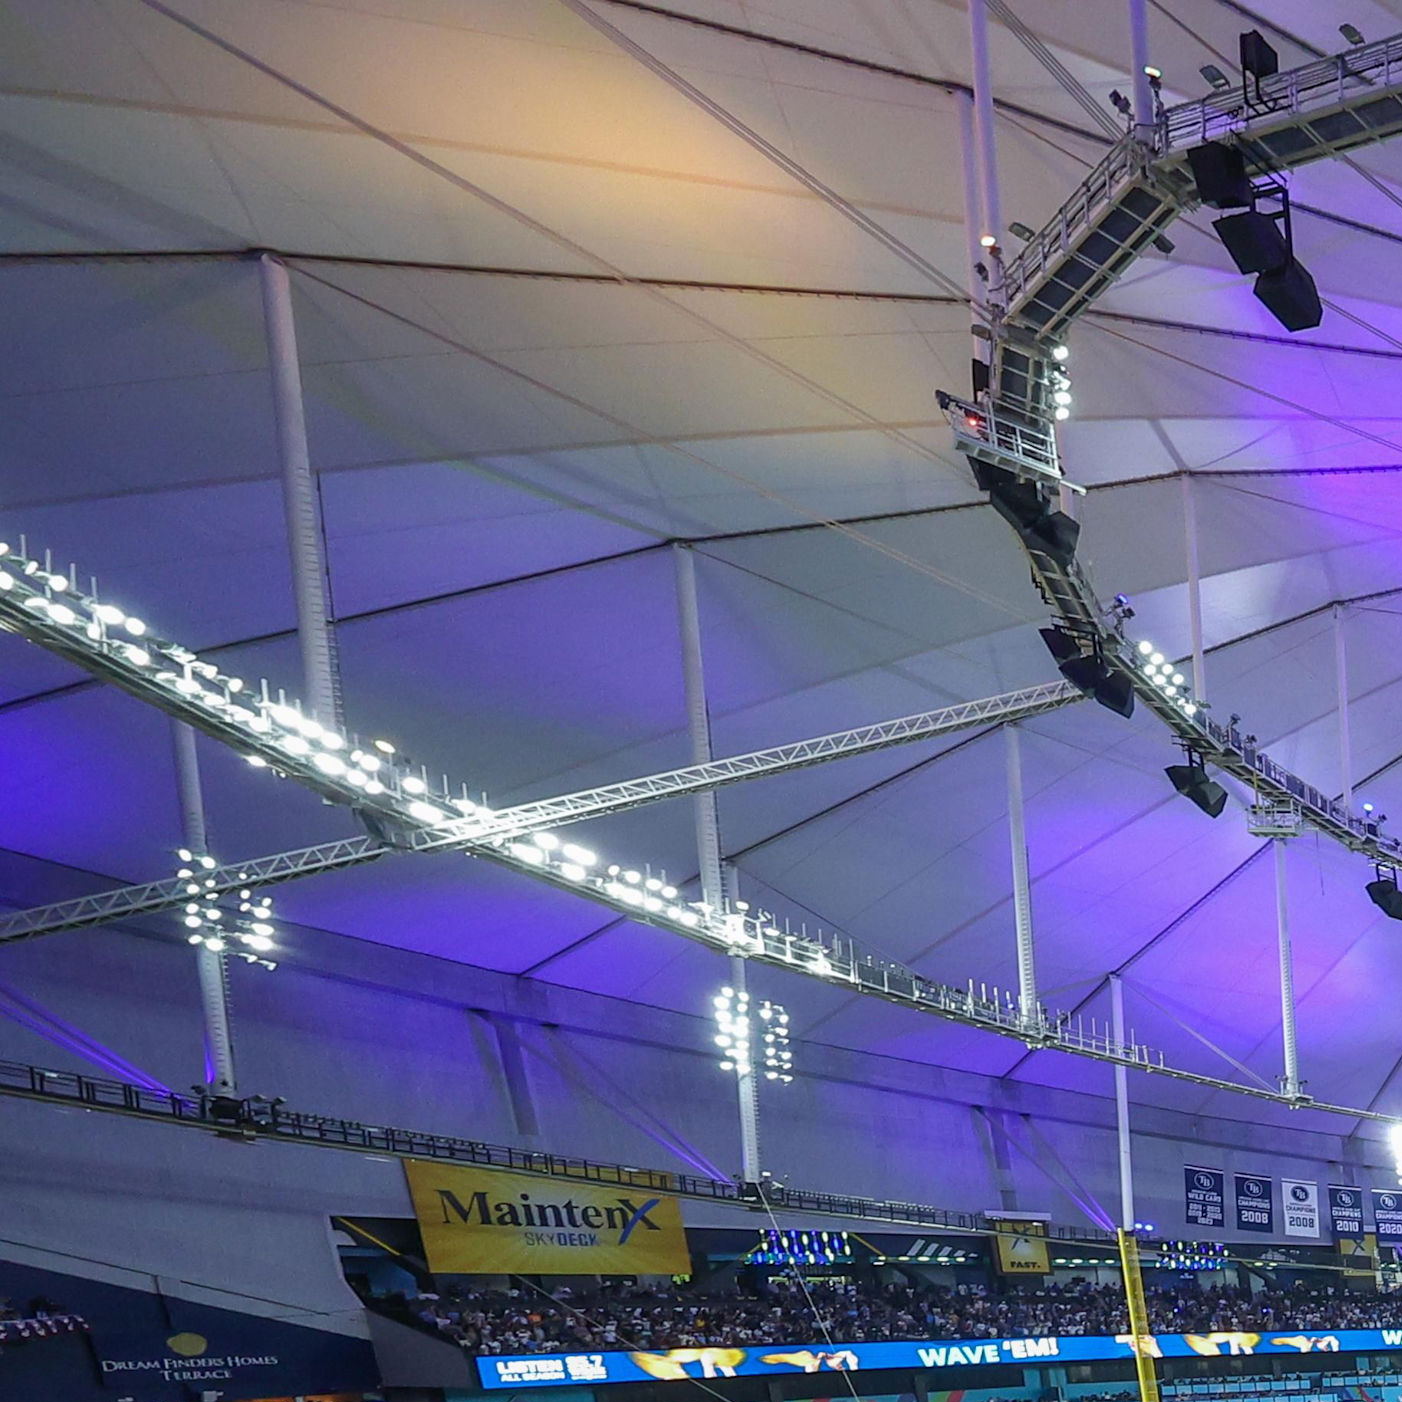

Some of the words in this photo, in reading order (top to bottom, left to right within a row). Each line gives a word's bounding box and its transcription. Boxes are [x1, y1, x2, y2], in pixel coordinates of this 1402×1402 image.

[434, 1189, 661, 1245] MaintenX
[1241, 1210, 1269, 1224] 2008
[1289, 1216, 1314, 1228] 2008
[1336, 1220, 1359, 1232] 2010
[1379, 1223, 1402, 1234] 2020
[524, 1231, 599, 1247] SKYDECK
[1010, 1261, 1041, 1269] FAST.
[917, 1344, 1000, 1367] WAVE
[1002, 1337, 1060, 1359] 'EM!
[102, 1360, 160, 1372] DREAM
[163, 1357, 226, 1370] FINDERS
[226, 1355, 279, 1367] HOMES
[159, 1369, 233, 1381] TERRACE
